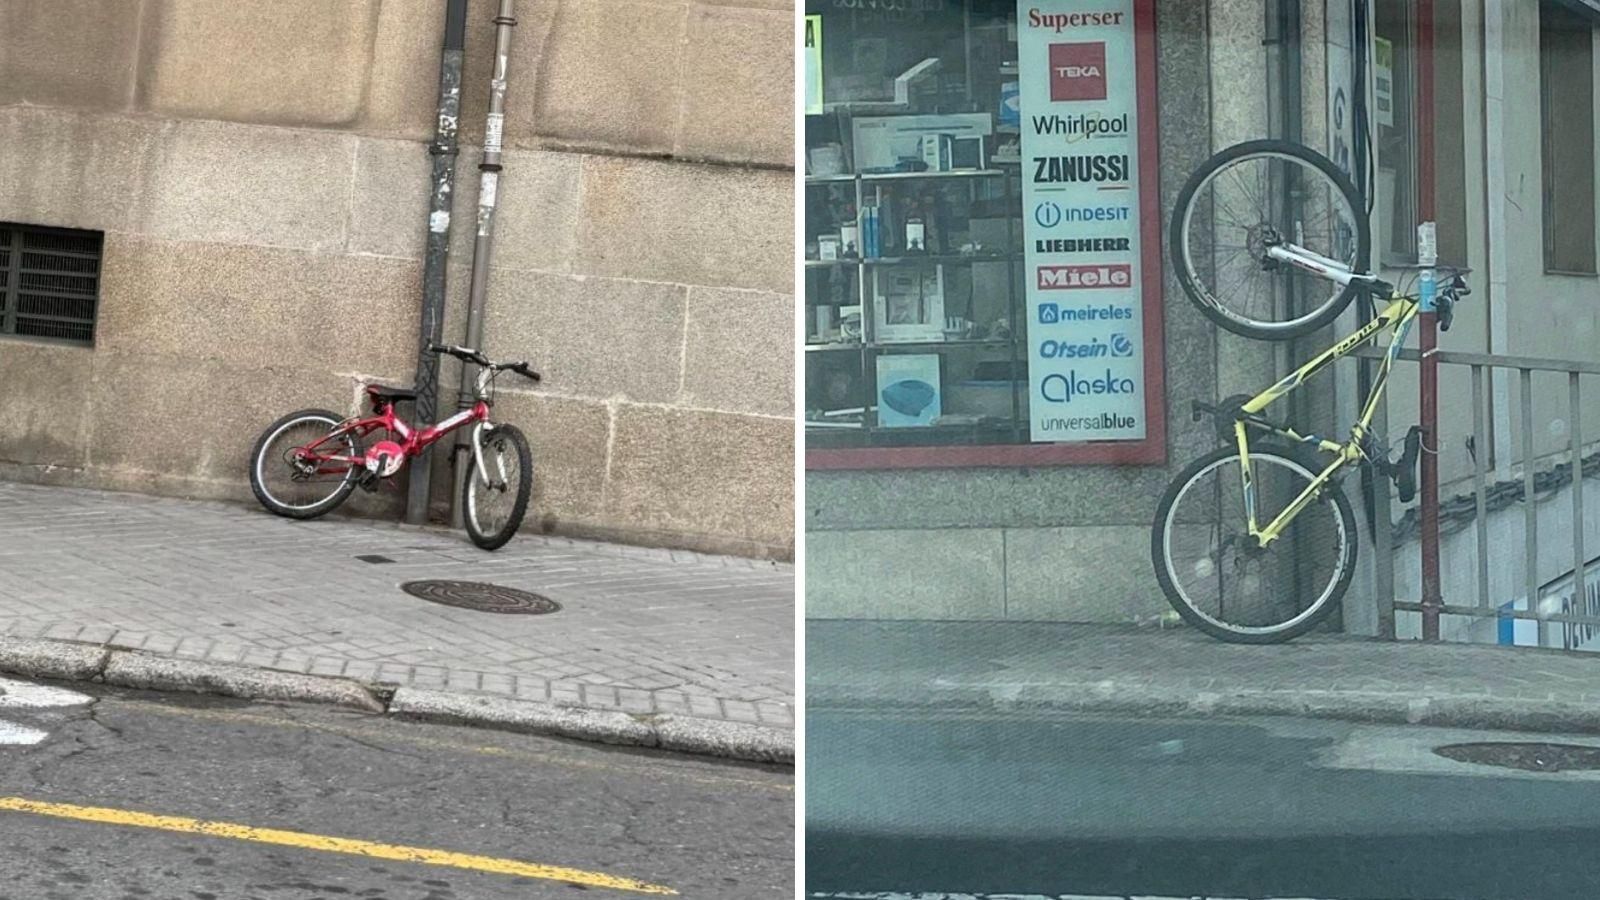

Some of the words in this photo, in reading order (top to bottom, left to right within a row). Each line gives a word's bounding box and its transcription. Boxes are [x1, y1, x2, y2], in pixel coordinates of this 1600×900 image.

[1029, 8, 1124, 33] Superser
[1055, 66, 1101, 78] TEKA
[1032, 112, 1128, 139] Whirlpool
[1033, 155, 1129, 183] ZANUSSI
[1036, 237, 1130, 253] LIEBHERR
[1039, 267, 1129, 287] Miele
[1061, 305, 1133, 321] meireles
[1040, 337, 1108, 359] Otsein
[1041, 413, 1136, 432] universalblue
